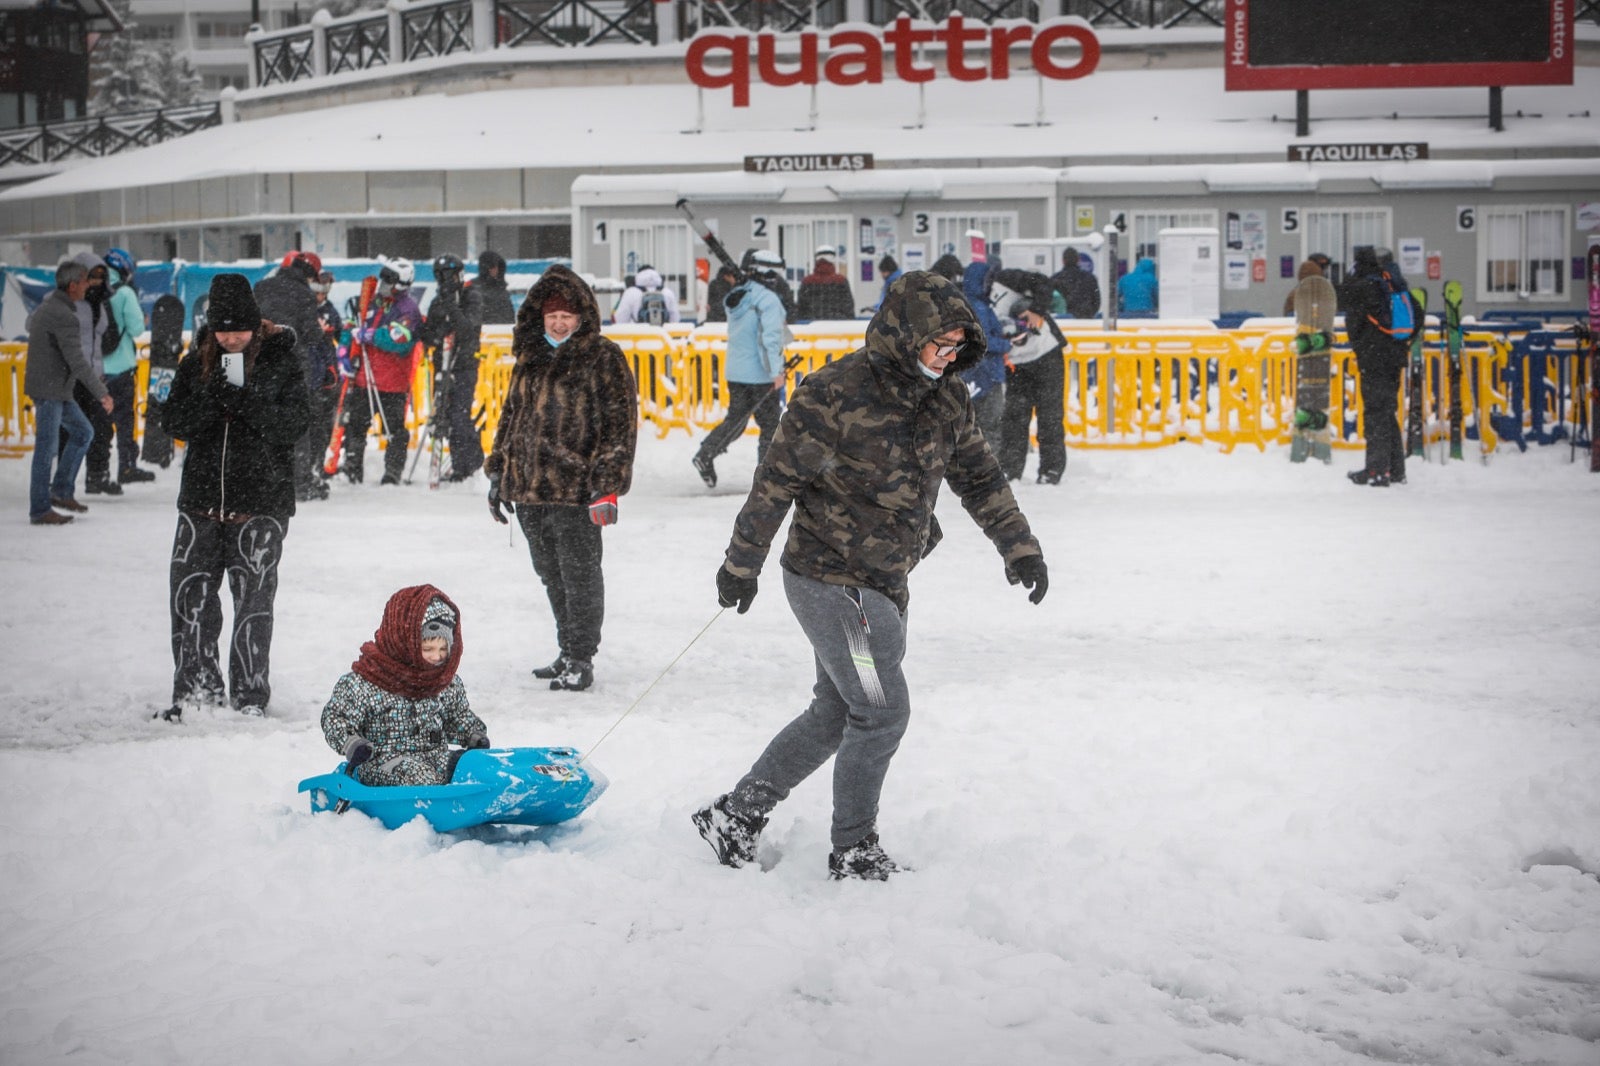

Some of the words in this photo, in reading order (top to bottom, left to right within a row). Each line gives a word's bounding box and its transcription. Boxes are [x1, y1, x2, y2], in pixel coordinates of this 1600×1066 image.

[1231, 10, 1245, 65] Home
[1553, 0, 1565, 59] uattro
[686, 17, 1100, 107] quattro
[1297, 145, 1418, 160] TAQUILLAS
[753, 156, 864, 171] TAQUILLAS
[754, 218, 766, 237] 2
[916, 213, 929, 233] 3
[1114, 213, 1127, 232] 4
[1284, 211, 1298, 231] 5
[1459, 208, 1474, 229] 6
[596, 222, 606, 241] 1
